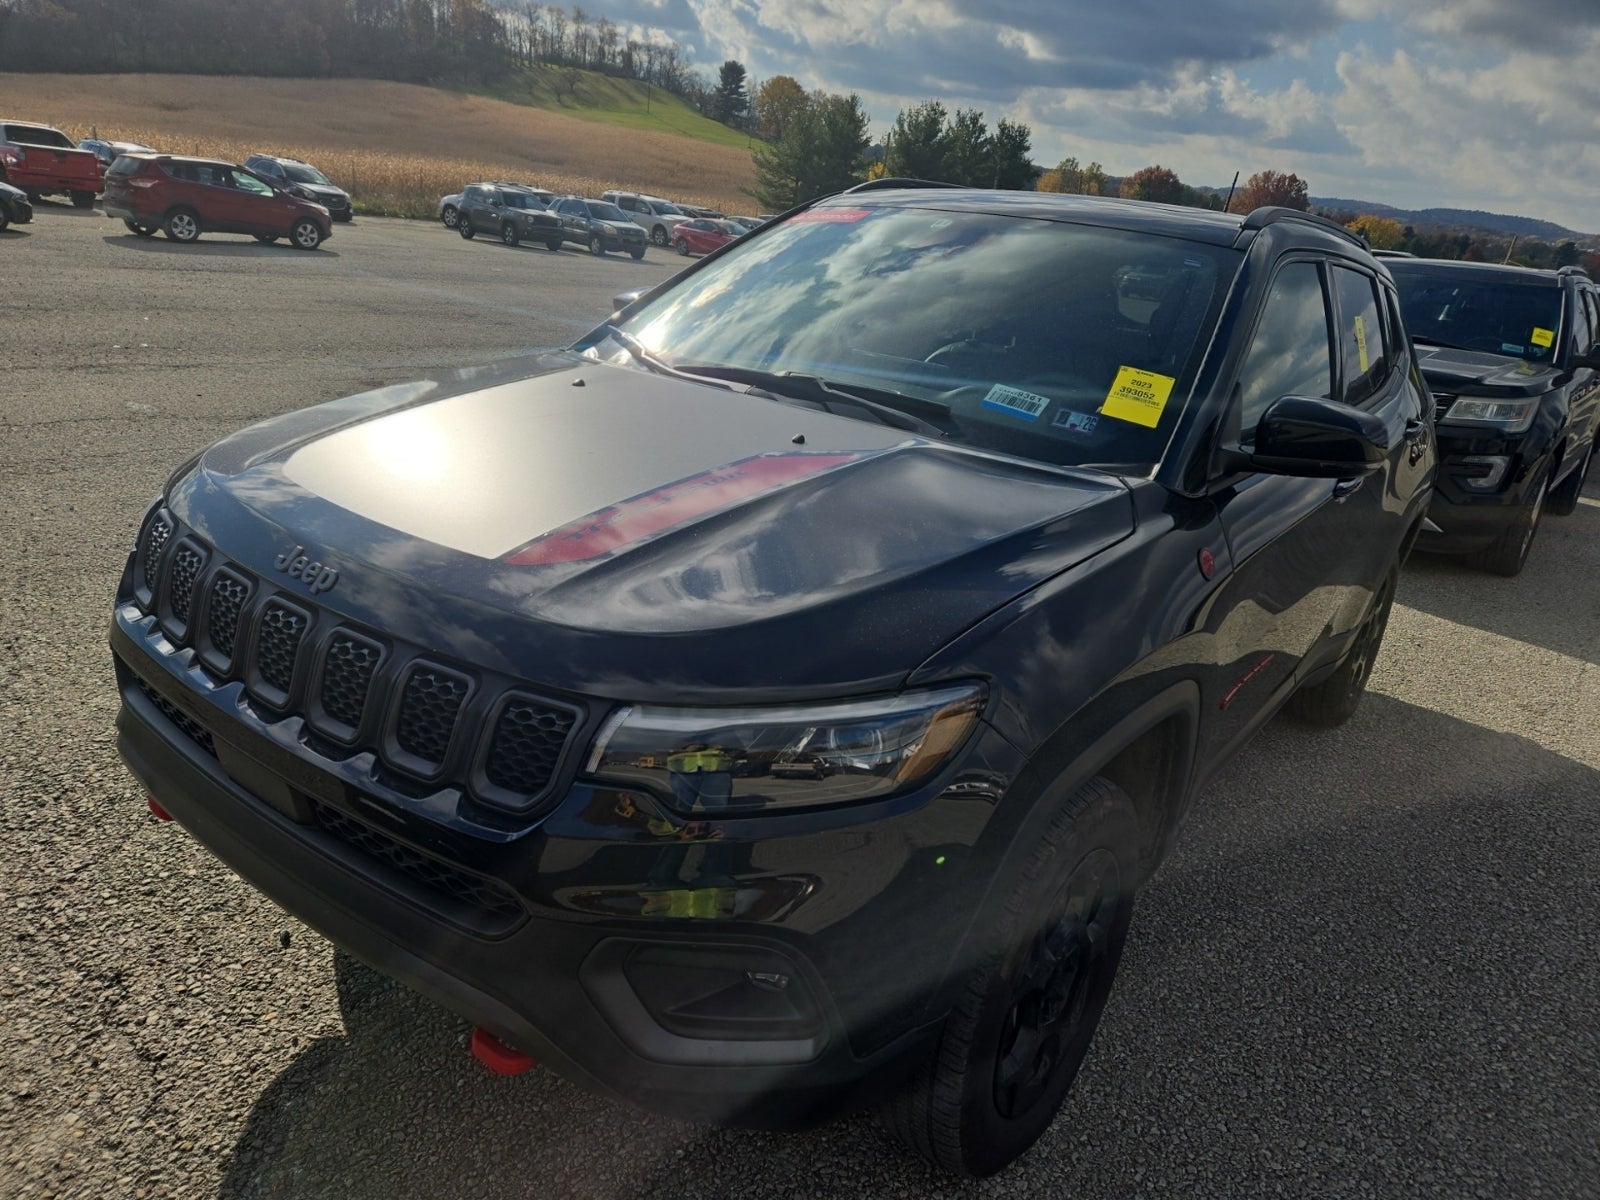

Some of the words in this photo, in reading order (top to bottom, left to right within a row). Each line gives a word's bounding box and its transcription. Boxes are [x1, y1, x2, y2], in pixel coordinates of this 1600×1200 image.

[1130, 379, 1152, 389] 2023
[1119, 385, 1156, 400] 393052
[274, 545, 339, 595] Jeep
